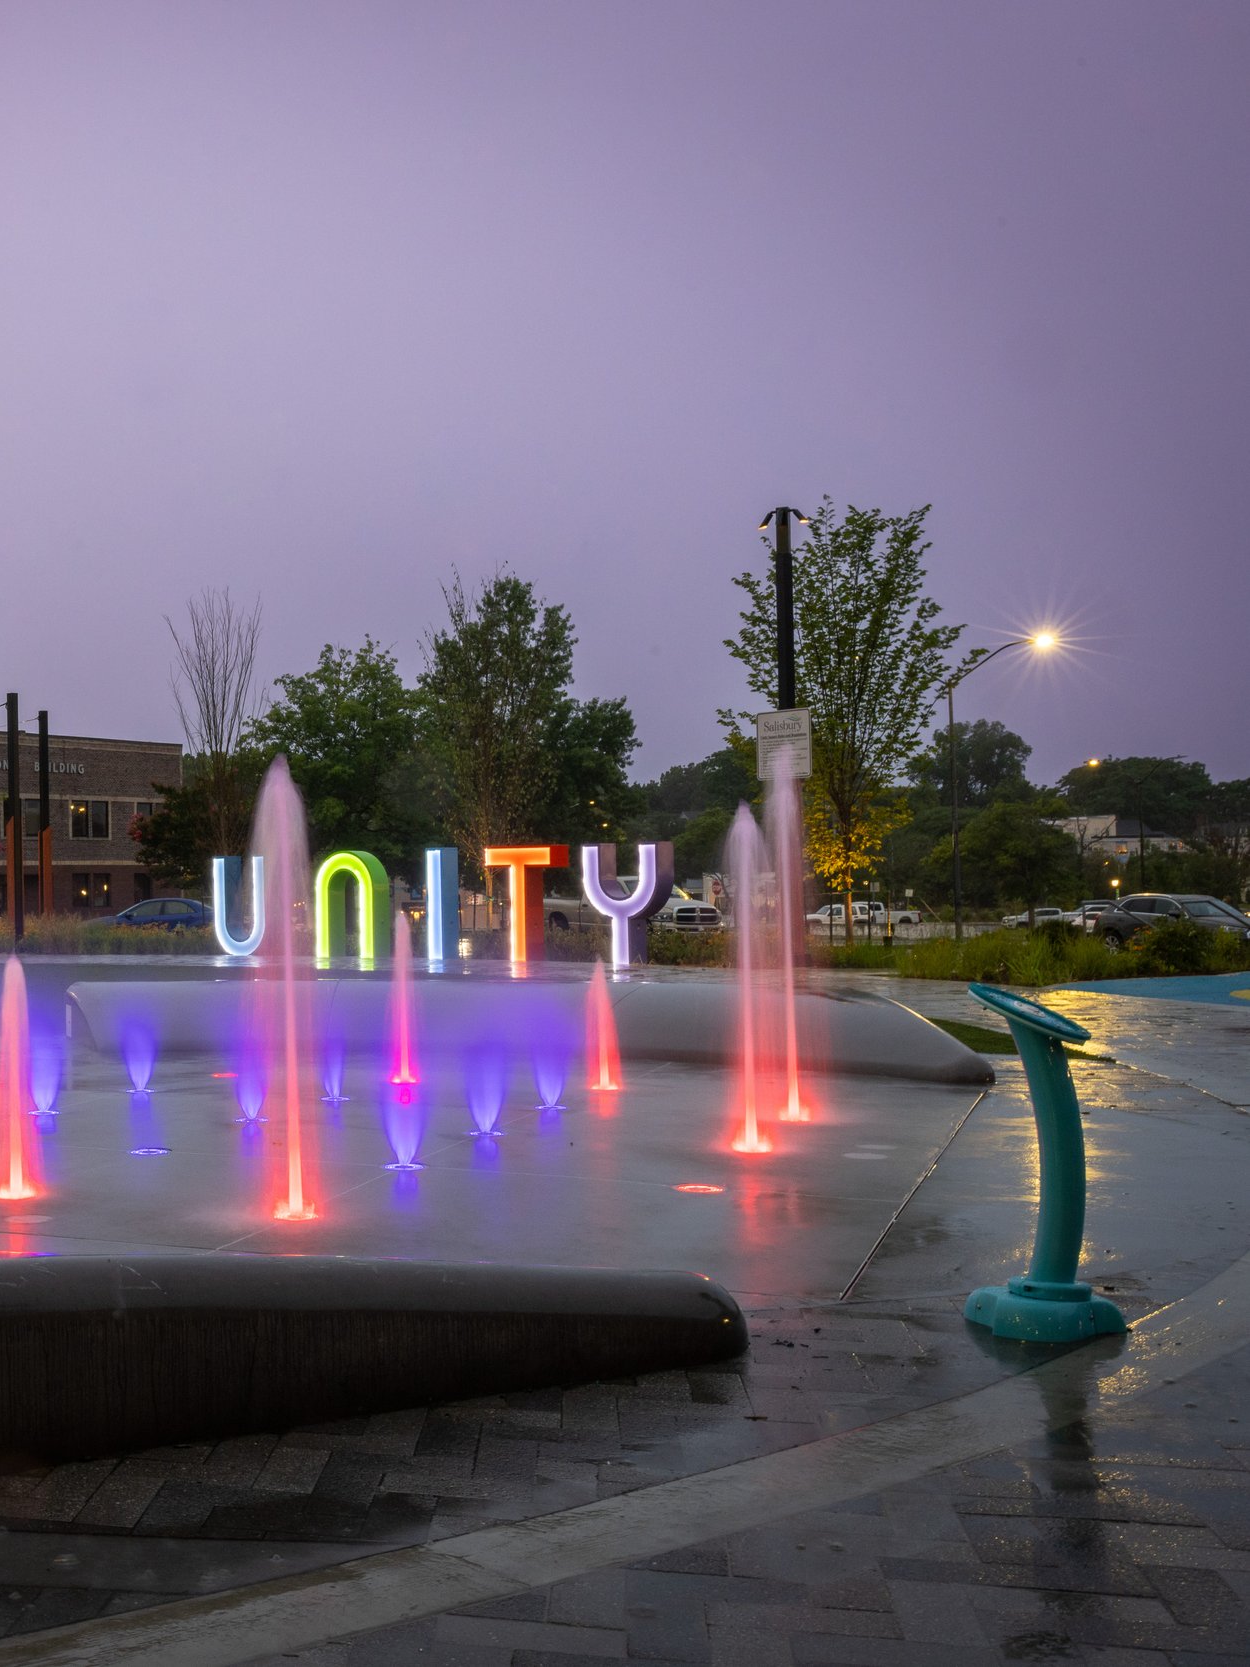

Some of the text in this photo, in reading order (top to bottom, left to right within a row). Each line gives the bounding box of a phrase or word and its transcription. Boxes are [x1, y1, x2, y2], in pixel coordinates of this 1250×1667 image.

[763, 720, 802, 732] Salisbury
[34, 761, 85, 774] BILDING
[212, 841, 675, 966] UNITY
